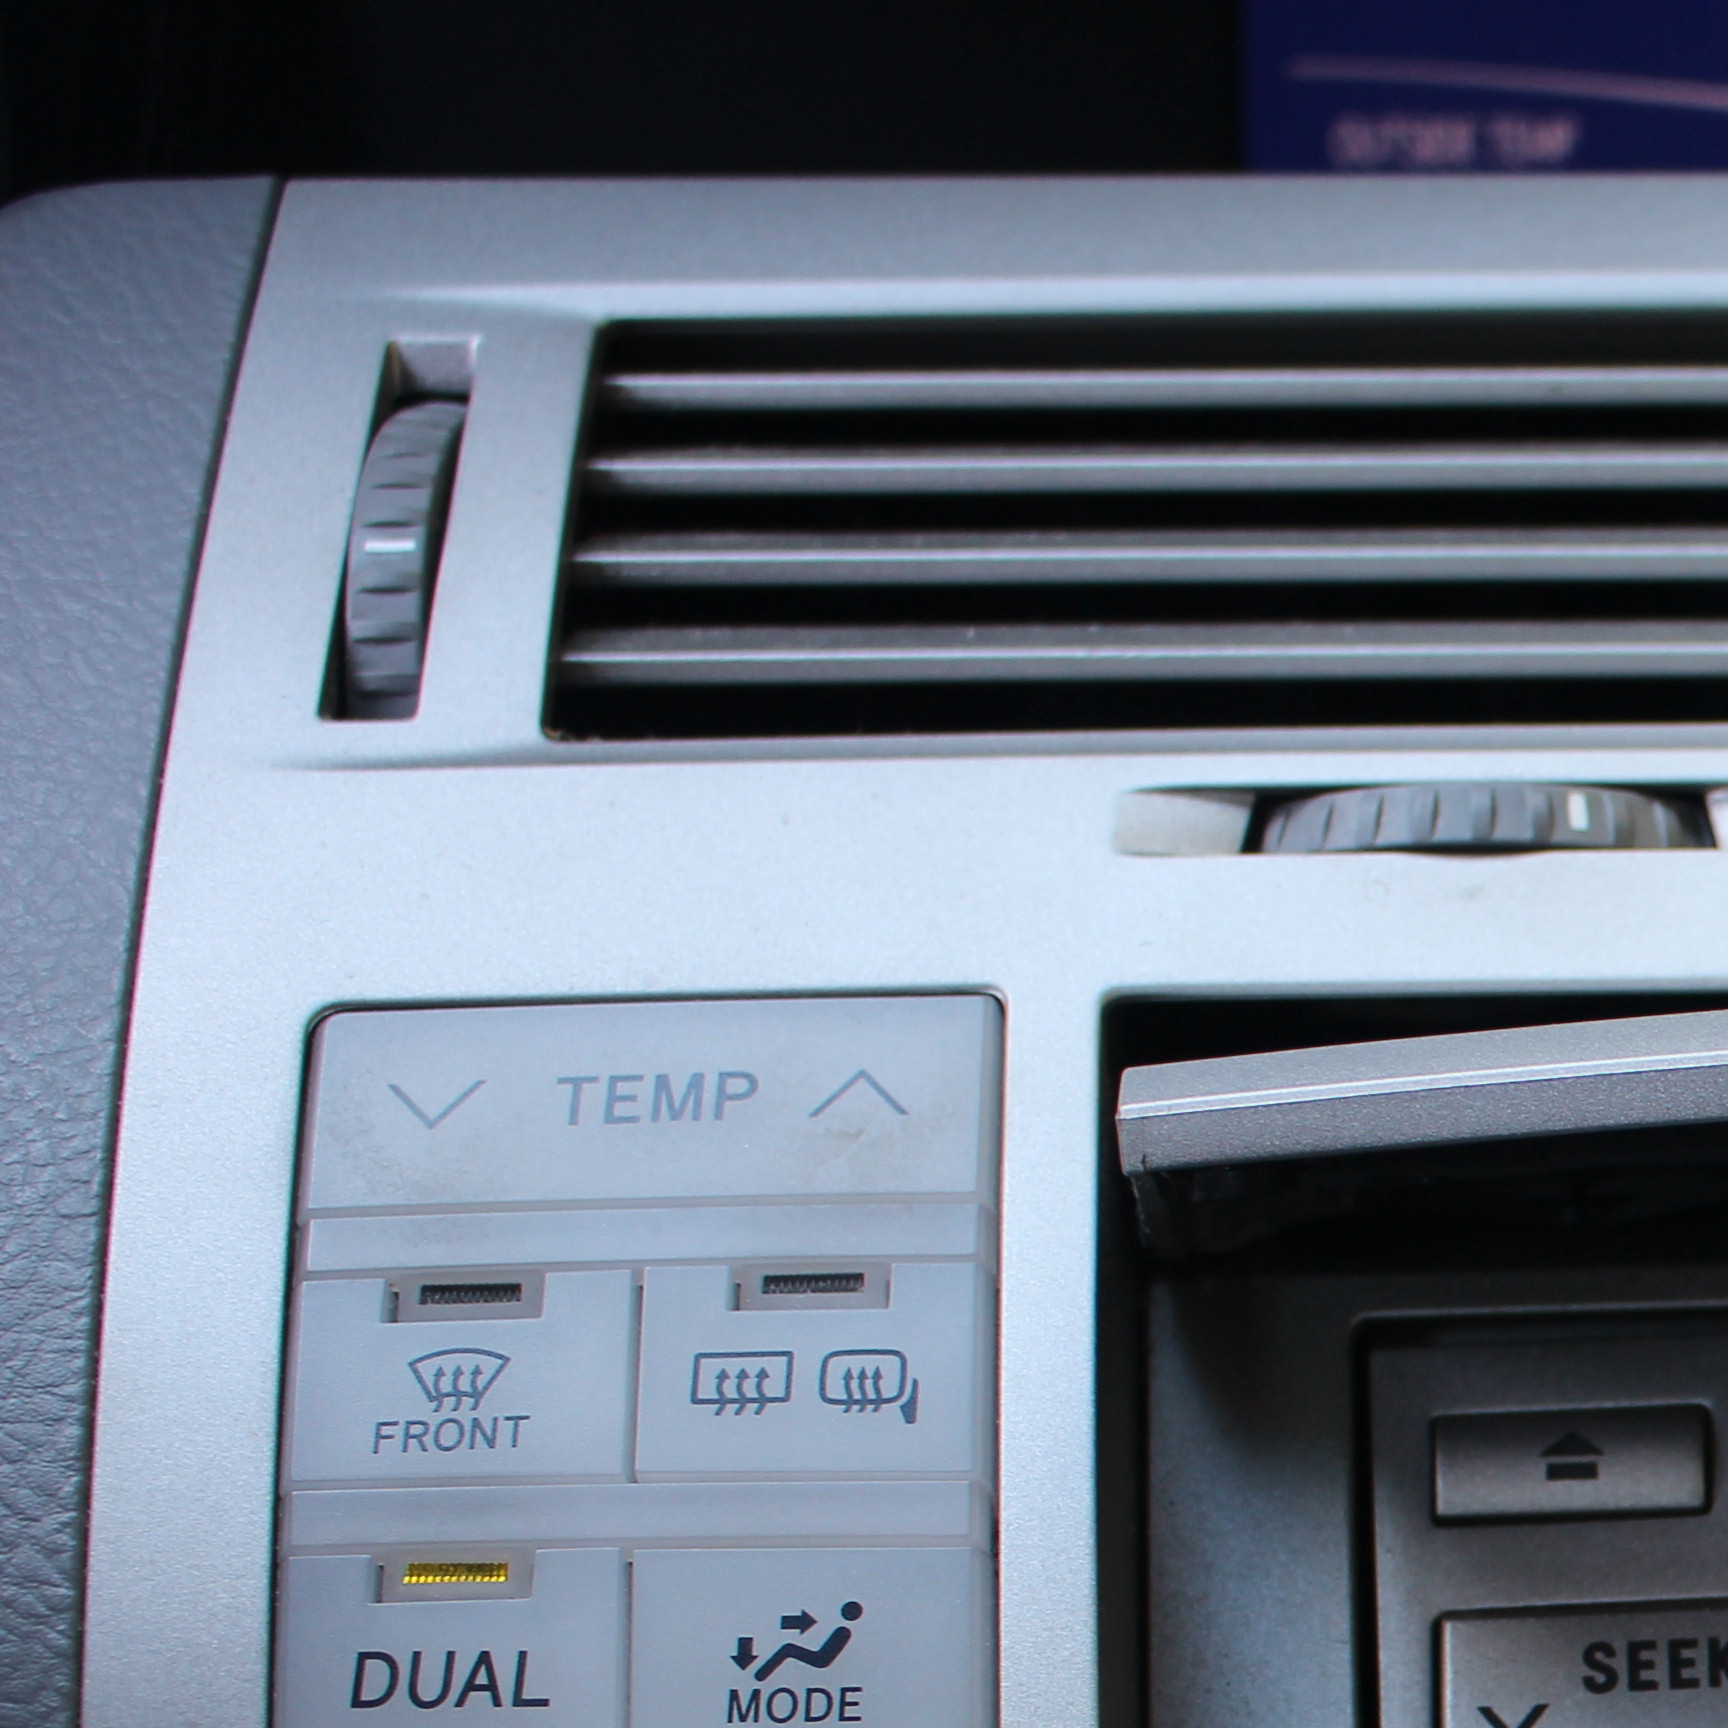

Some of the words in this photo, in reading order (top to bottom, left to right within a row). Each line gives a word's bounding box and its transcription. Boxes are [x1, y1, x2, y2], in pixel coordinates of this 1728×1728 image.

[556, 1072, 759, 1128] TEMP
[371, 1415, 530, 1454] FRONT
[350, 1650, 551, 1709] DUAL
[726, 1686, 863, 1724] MODE
